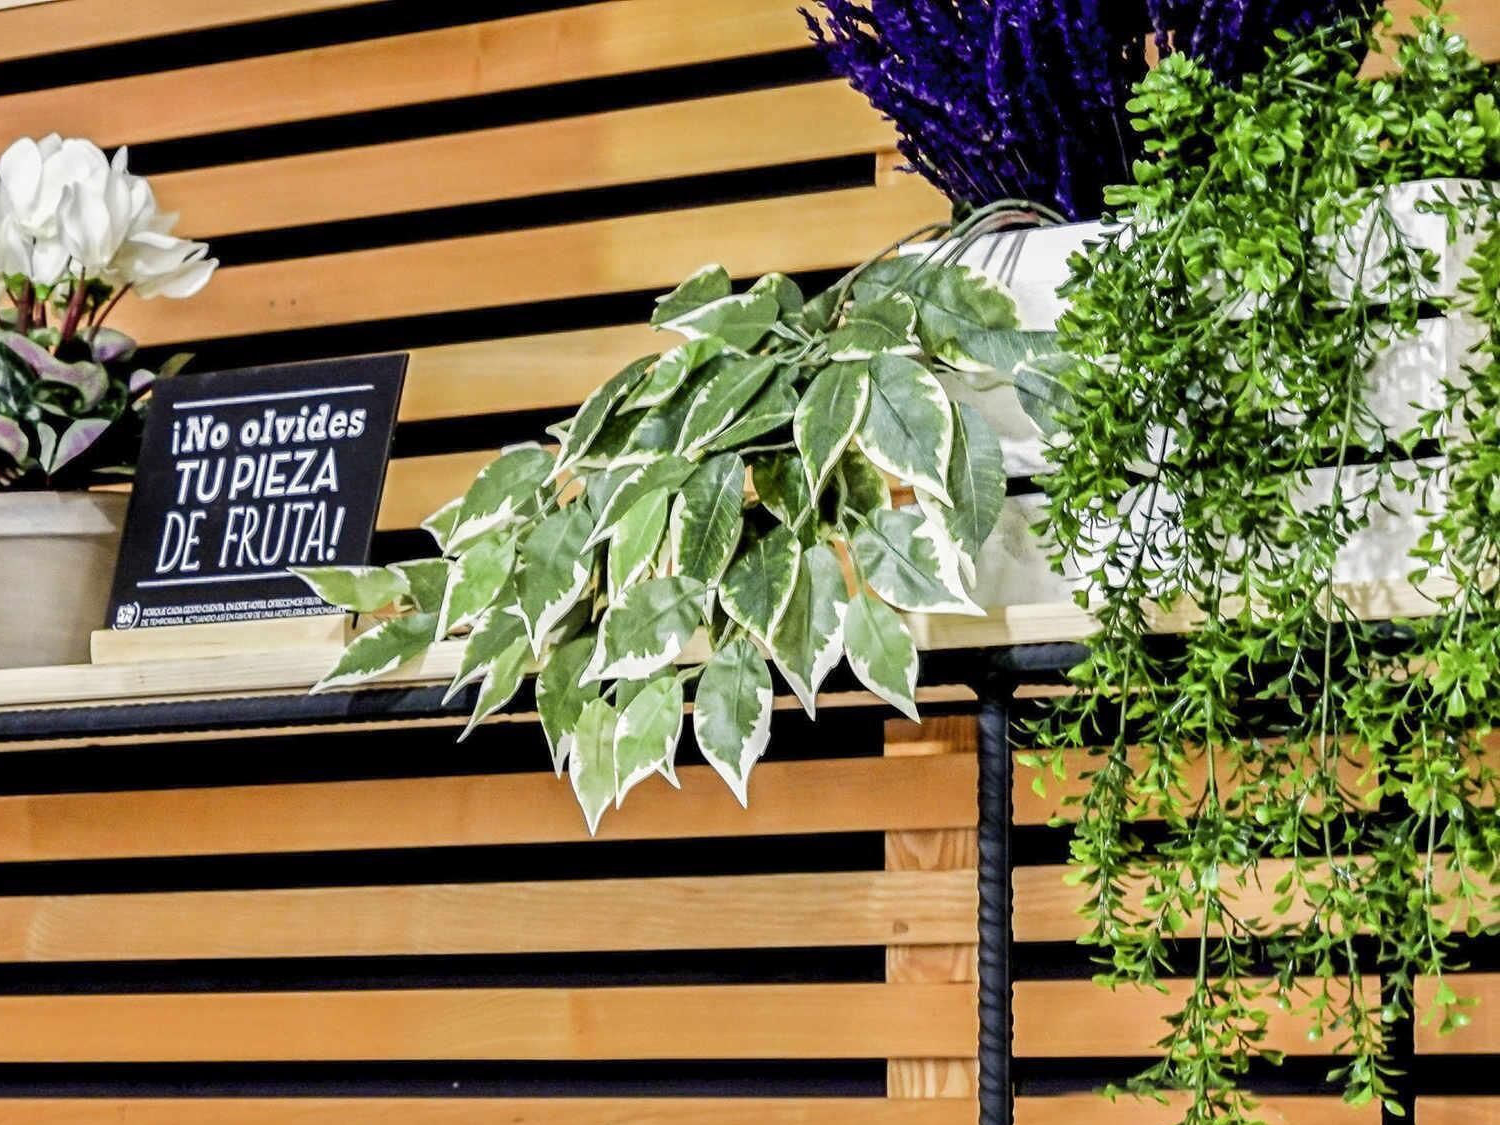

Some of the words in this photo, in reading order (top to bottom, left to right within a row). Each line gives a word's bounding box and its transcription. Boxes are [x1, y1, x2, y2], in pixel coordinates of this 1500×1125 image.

[171, 413, 230, 455] ¡No
[239, 403, 367, 447] olvides
[175, 458, 227, 505] TU
[228, 447, 339, 500] PIEZA
[155, 510, 207, 574] DE
[217, 501, 346, 568] FRUTA!
